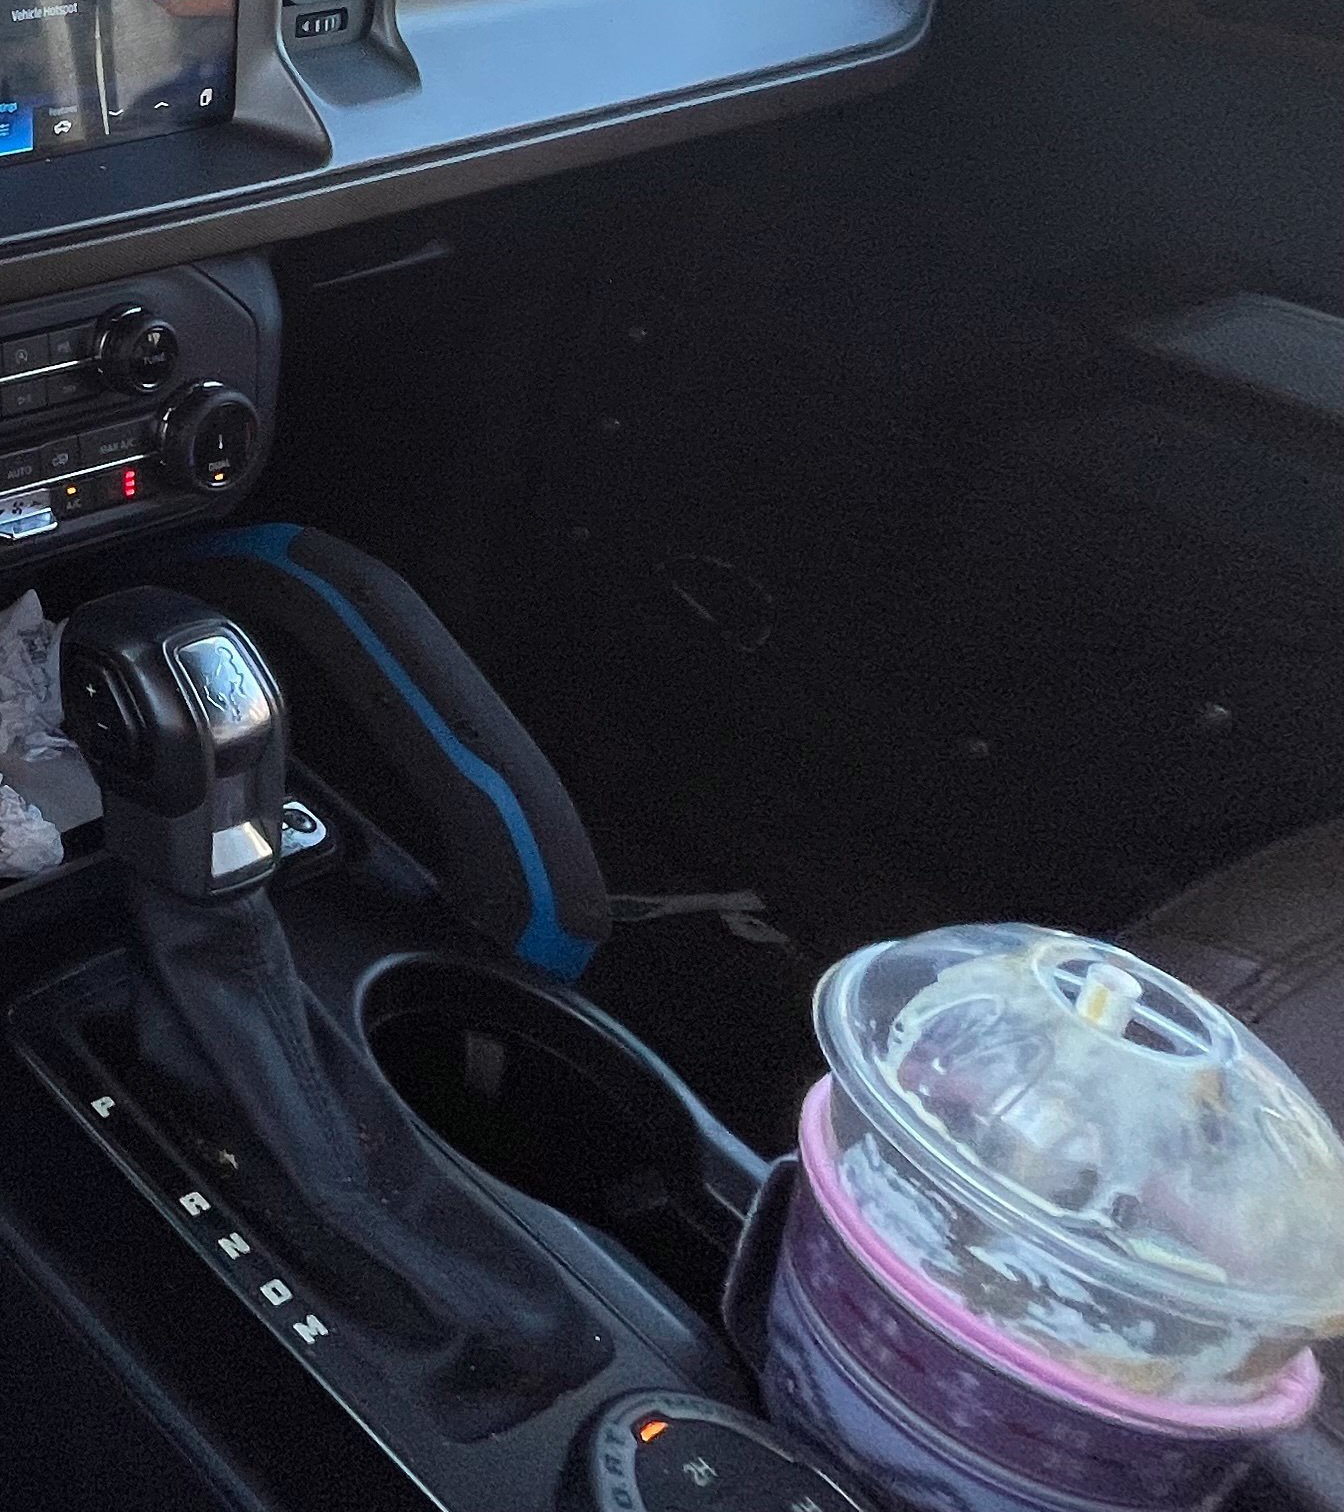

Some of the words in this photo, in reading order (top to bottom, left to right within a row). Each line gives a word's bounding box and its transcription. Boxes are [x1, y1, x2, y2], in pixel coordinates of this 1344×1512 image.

[12, 6, 42, 22] Vehicle
[43, 2, 79, 18] Hotspot
[7, 465, 32, 479] AUTO
[90, 1096, 116, 1119] P
[218, 1232, 251, 1260] N
[293, 1314, 329, 1345] M
